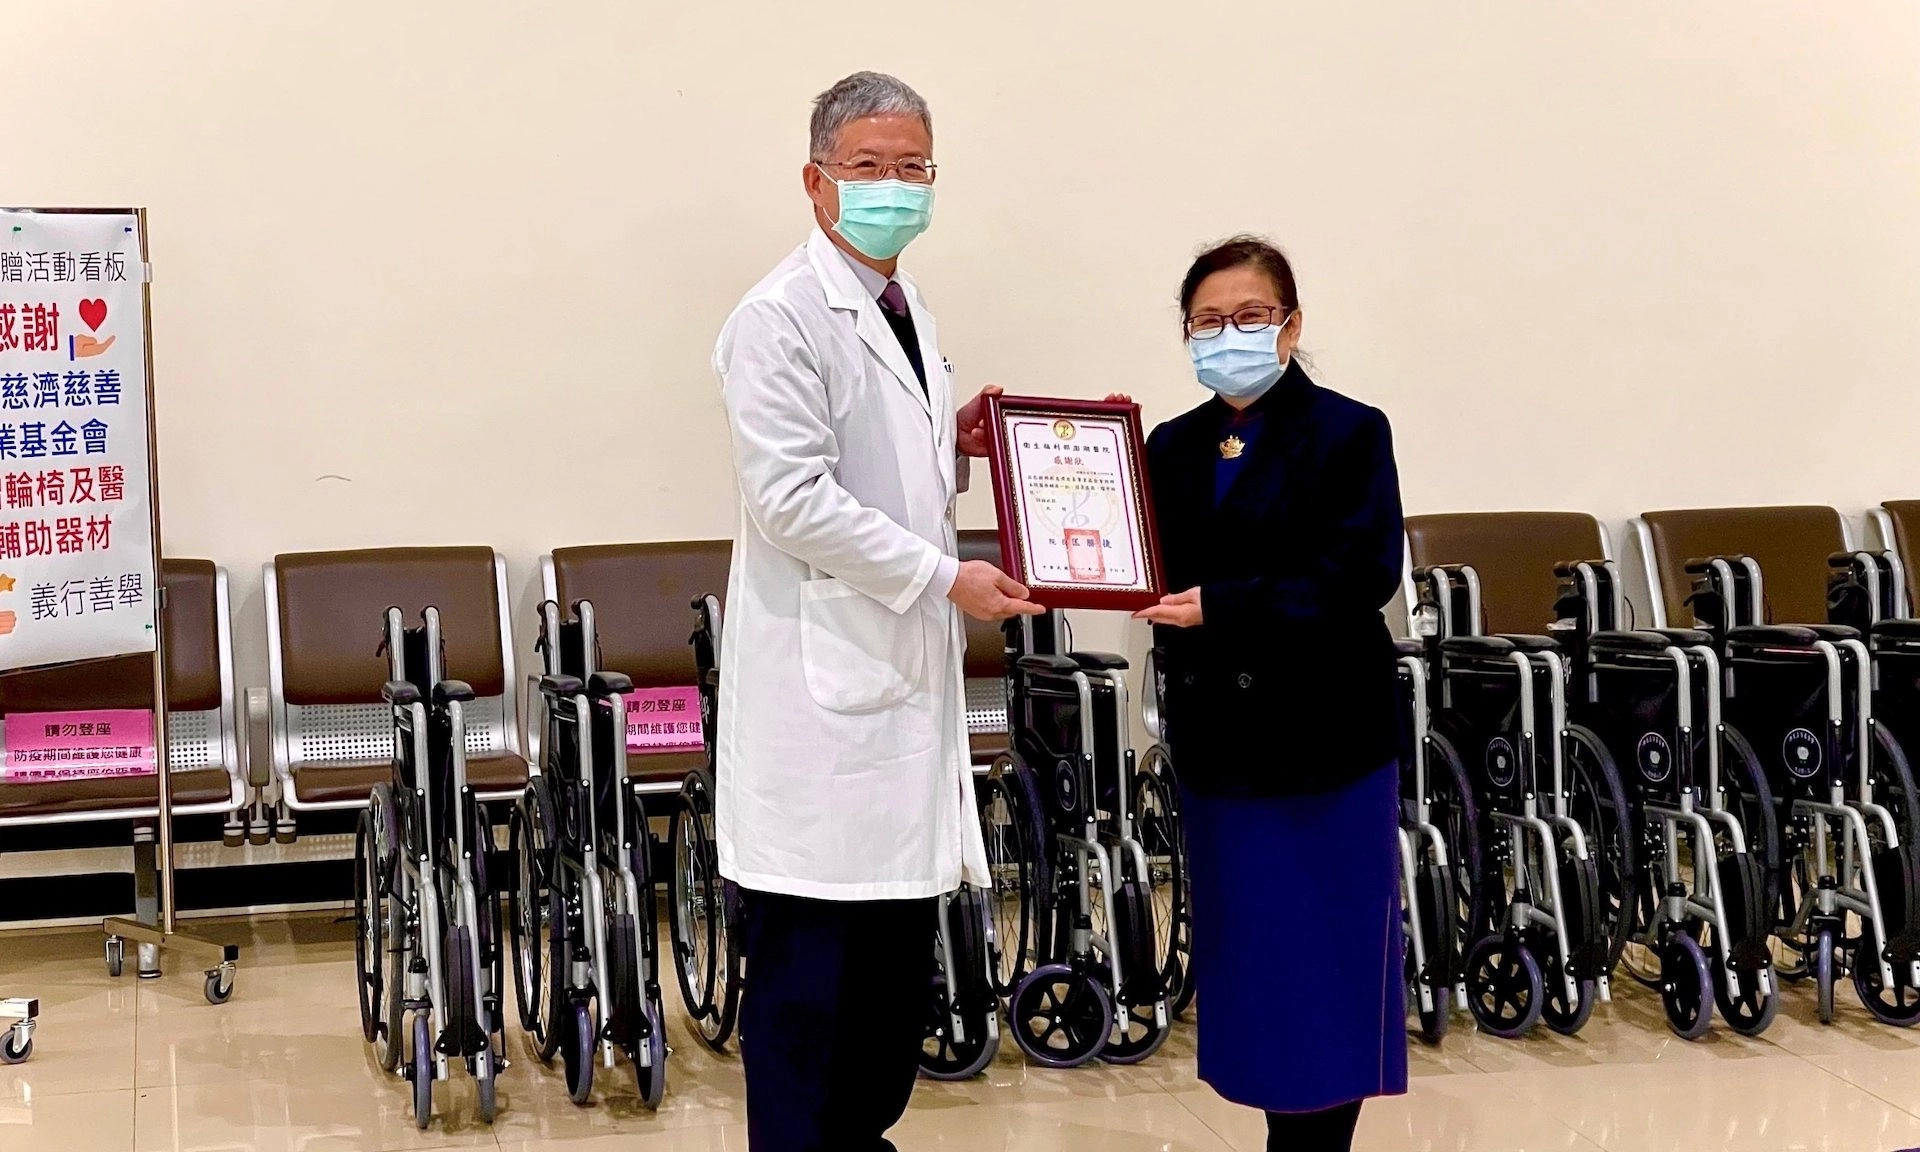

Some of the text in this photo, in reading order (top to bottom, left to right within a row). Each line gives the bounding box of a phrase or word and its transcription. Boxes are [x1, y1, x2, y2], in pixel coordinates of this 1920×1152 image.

[0, 251, 127, 283] 贈活動看板
[0, 302, 60, 352] 感謝
[0, 369, 121, 410] 慈濟慈善
[0, 465, 125, 510] 輪椅及醫
[0, 513, 112, 560] 輔助器材
[30, 573, 143, 620] 義行善舉
[625, 698, 686, 713] 請勿登座
[45, 722, 111, 737] 請勿登座
